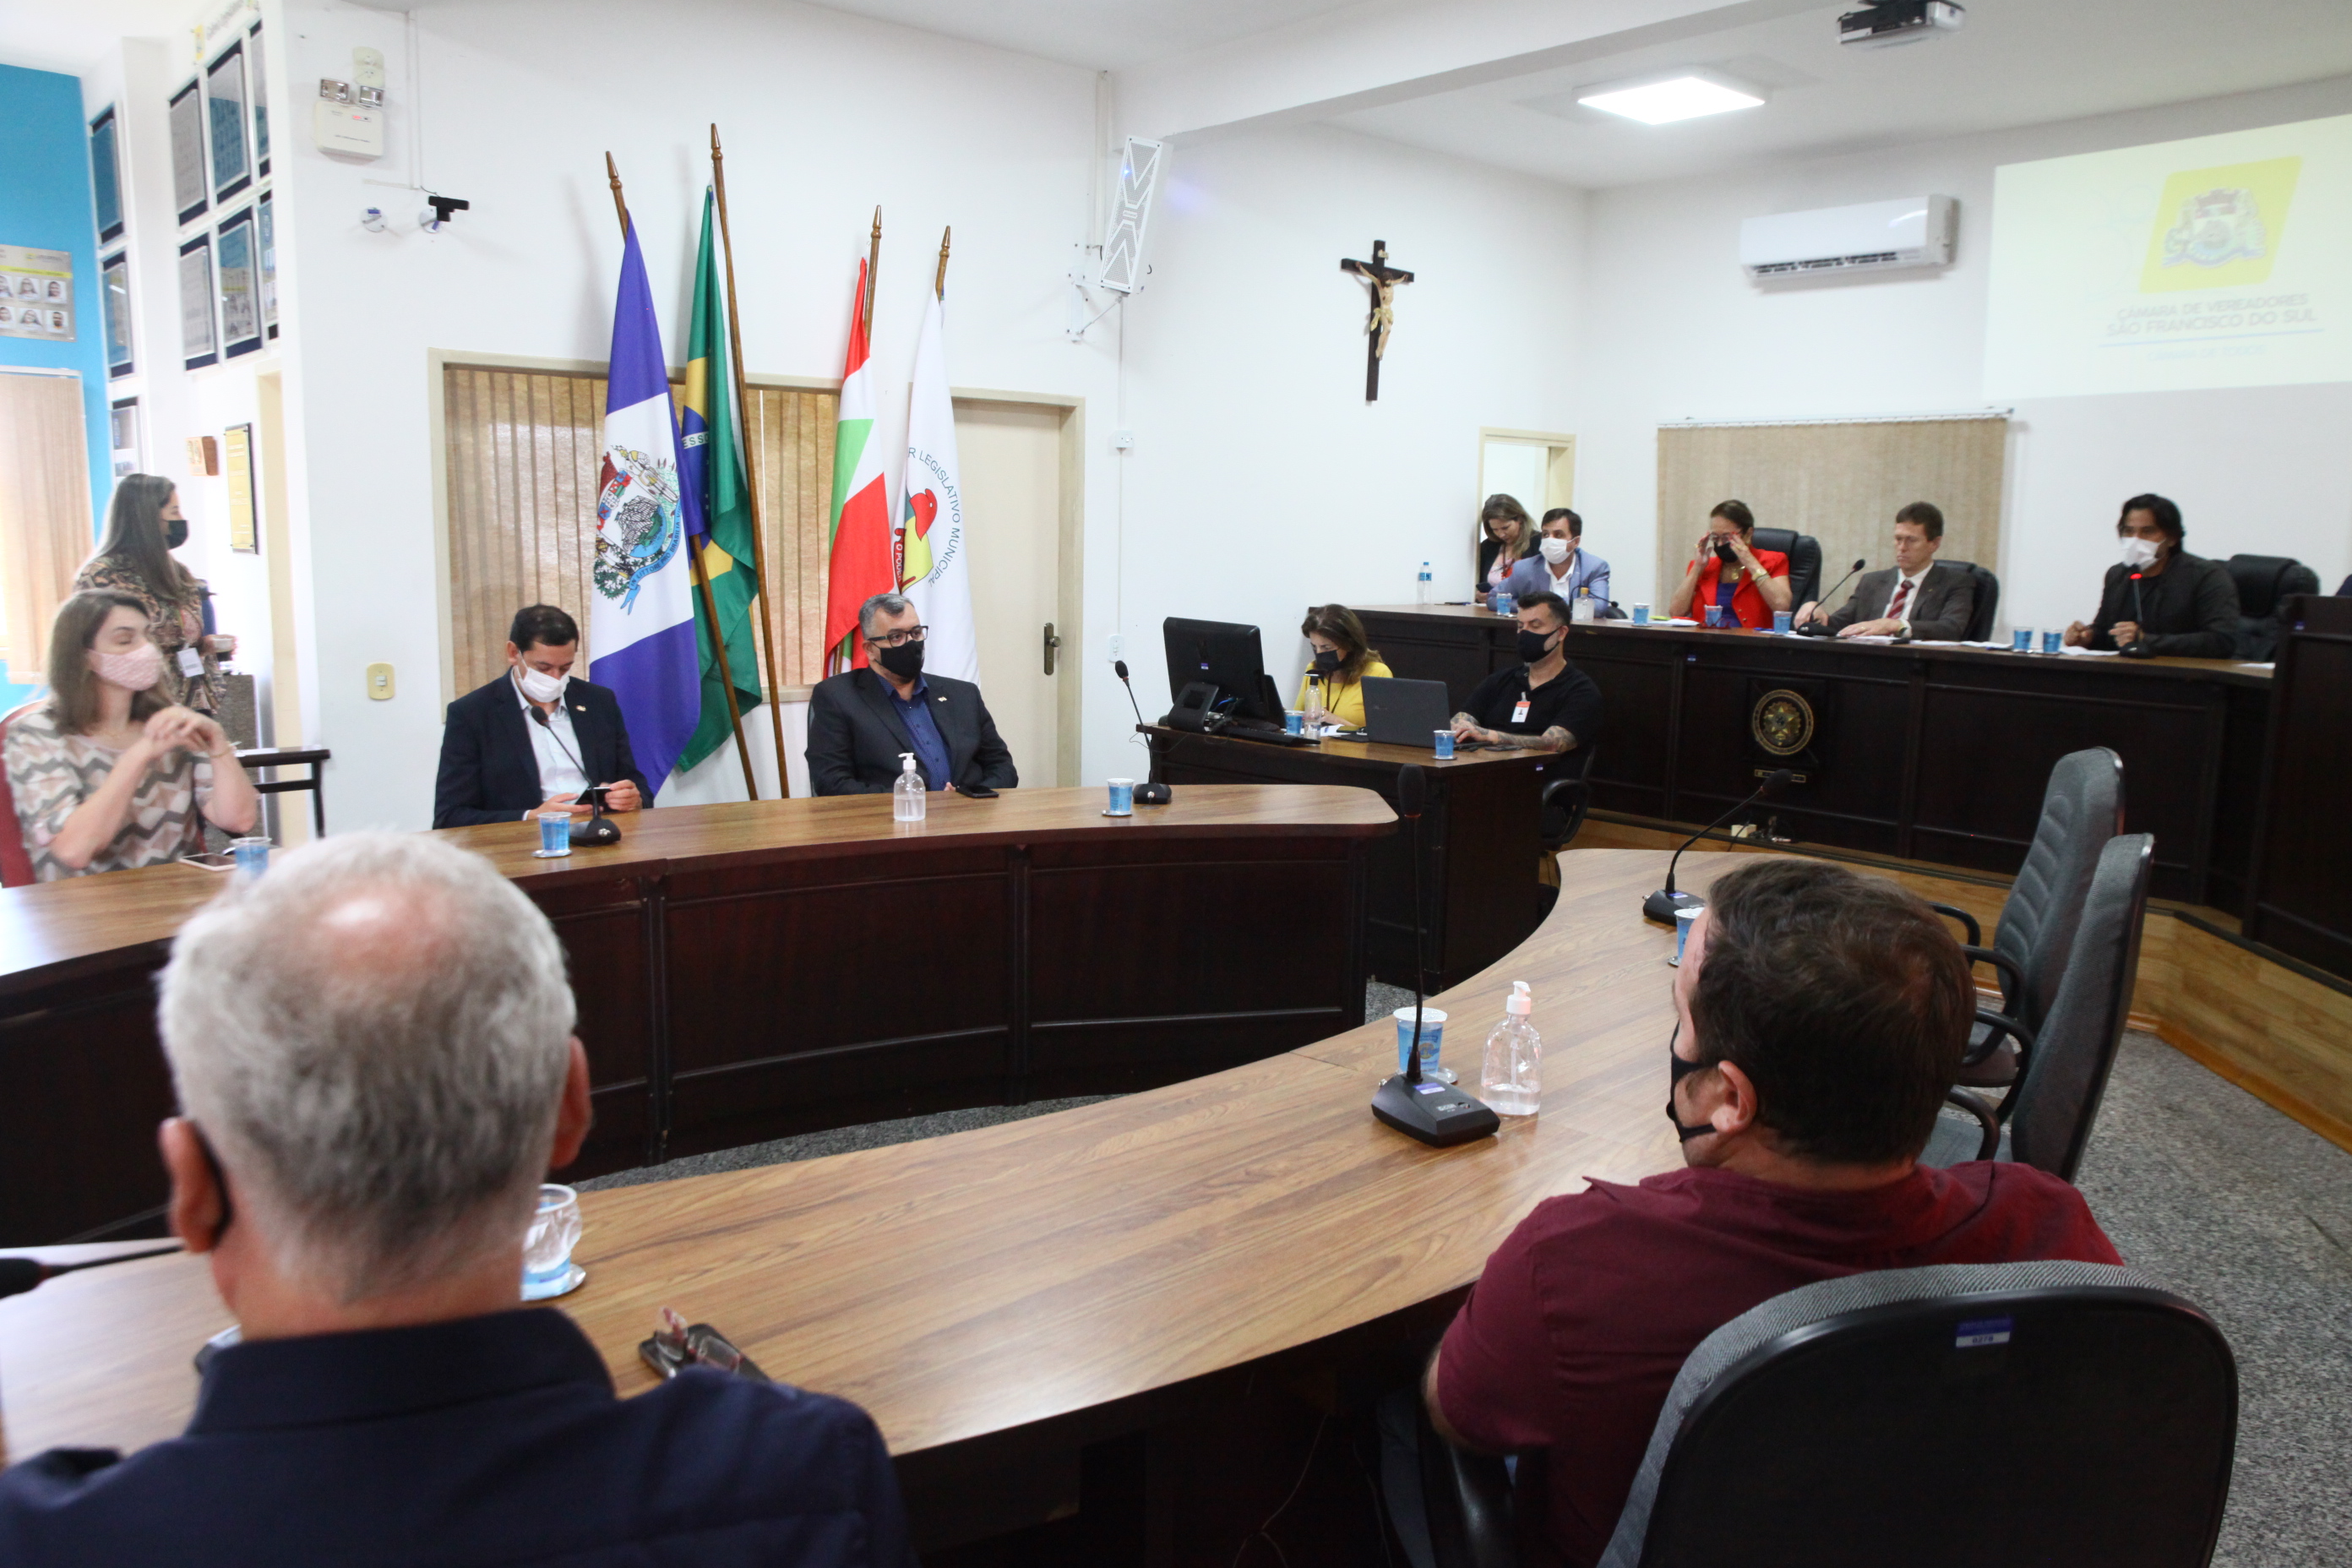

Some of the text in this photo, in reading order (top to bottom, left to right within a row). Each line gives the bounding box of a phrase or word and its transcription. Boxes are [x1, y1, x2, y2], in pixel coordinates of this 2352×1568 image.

[2183, 301, 2202, 314] DE
[2207, 293, 2308, 313] VEREADORES
[2146, 313, 2244, 334] FRANCISCO
[2249, 311, 2277, 326] DO
[2283, 308, 2318, 324] SUL
[919, 449, 961, 523] LEGISLATIVO
[670, 522, 681, 553] BRASILIA
[928, 527, 961, 587] MUNICIPAL
